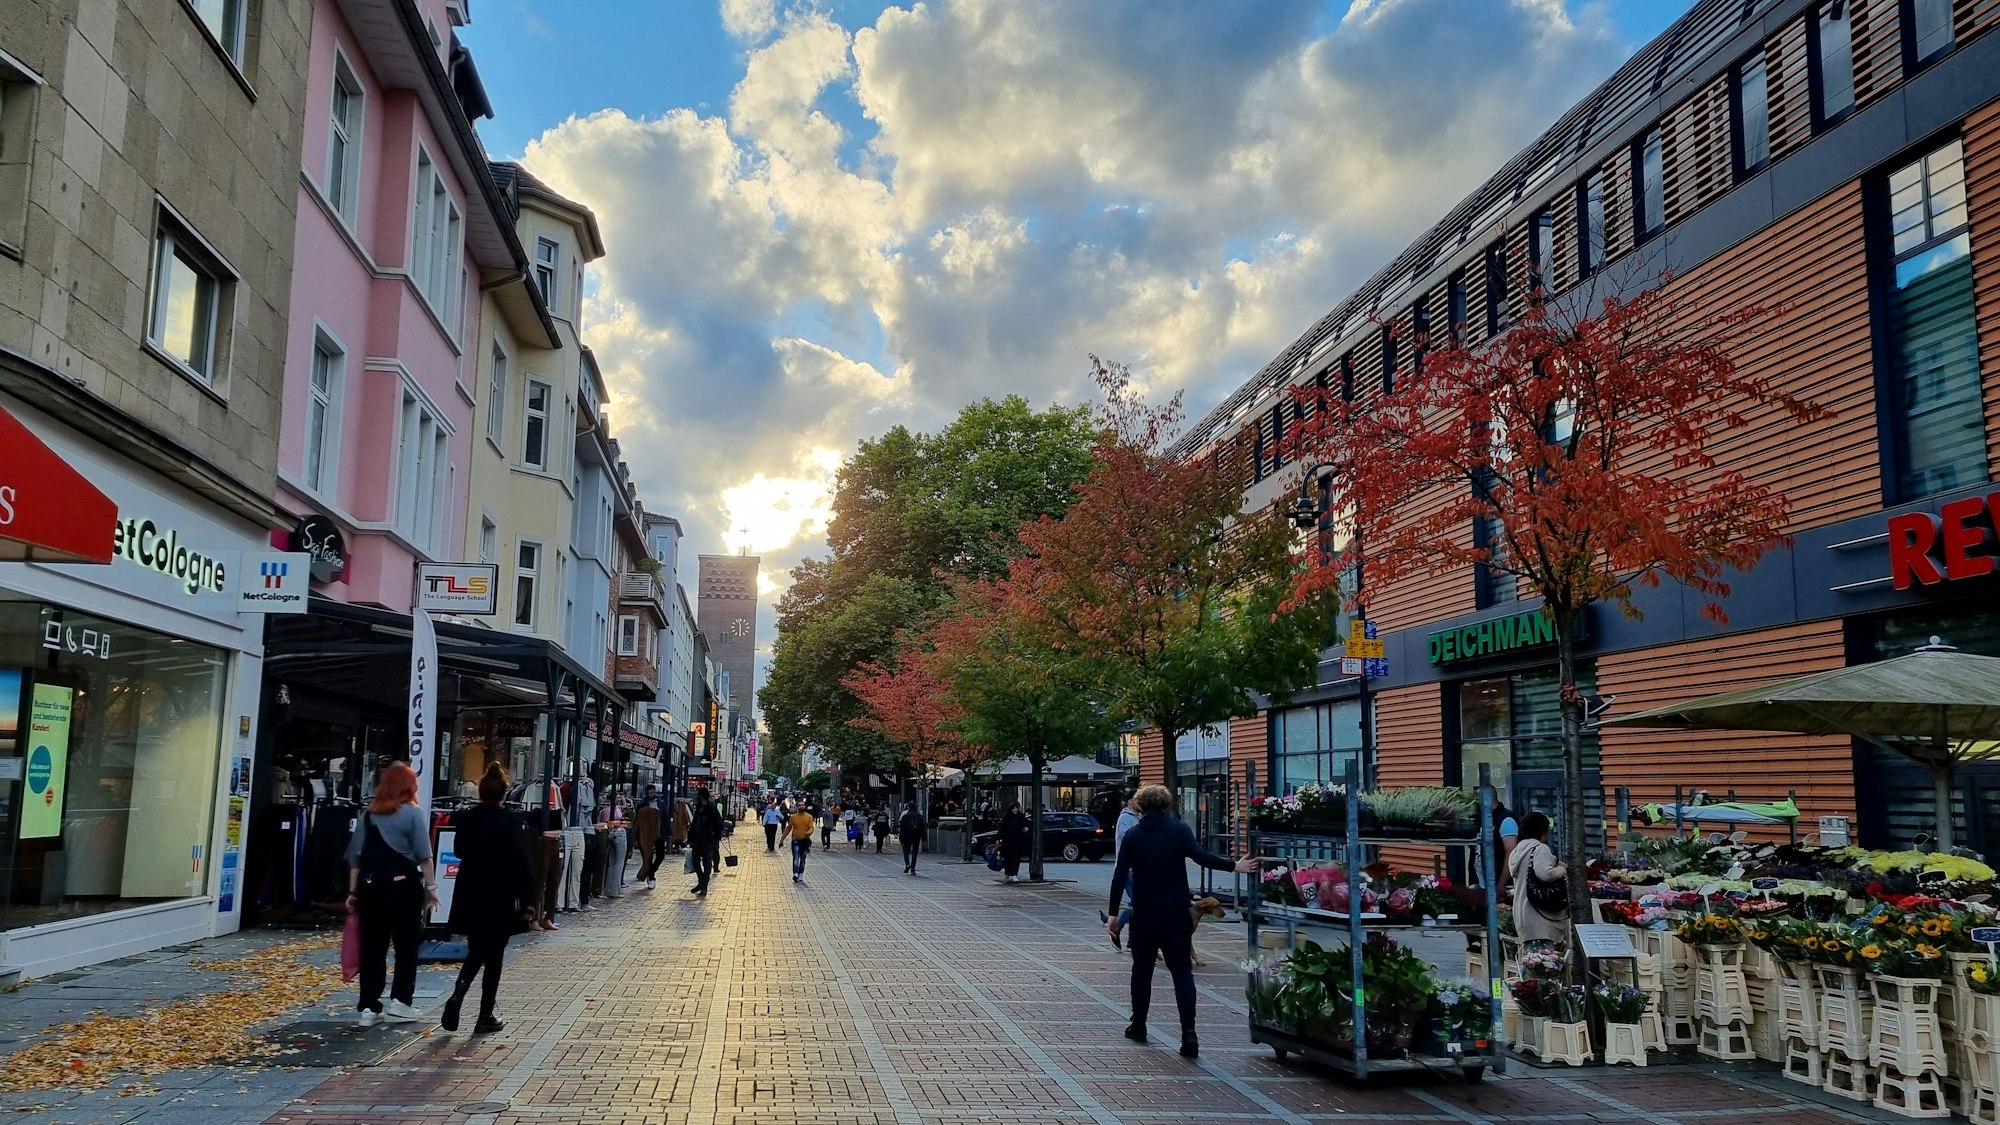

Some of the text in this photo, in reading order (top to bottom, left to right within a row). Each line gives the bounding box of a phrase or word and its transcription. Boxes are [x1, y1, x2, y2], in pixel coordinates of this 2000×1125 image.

[114, 517, 226, 595] etCologne
[424, 575, 489, 594] TLS
[242, 591, 301, 603] NetCologne
